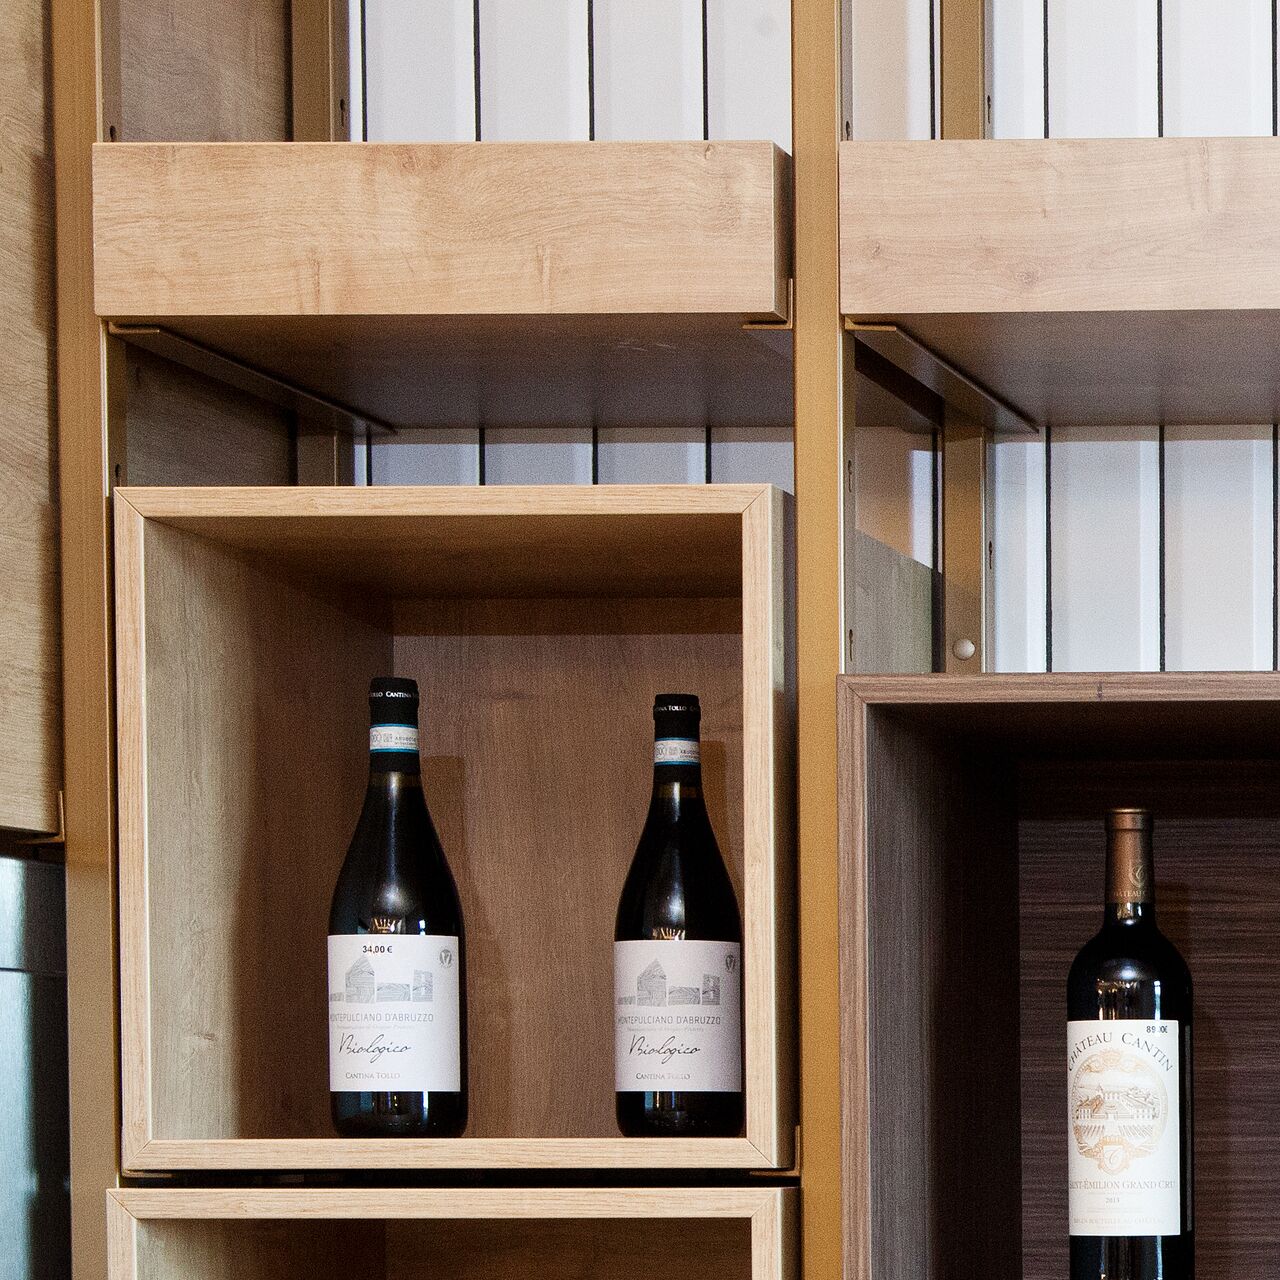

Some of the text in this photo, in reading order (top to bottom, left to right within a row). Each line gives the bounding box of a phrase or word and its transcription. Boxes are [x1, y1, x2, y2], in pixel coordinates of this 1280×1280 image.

[362, 945, 393, 955] 34,00 €
[339, 1032, 412, 1064] Biologico
[629, 1034, 701, 1064] Biologico
[1068, 1032, 1174, 1072] CHÂTEAU CANTIN
[345, 1071, 375, 1080] CANTINA
